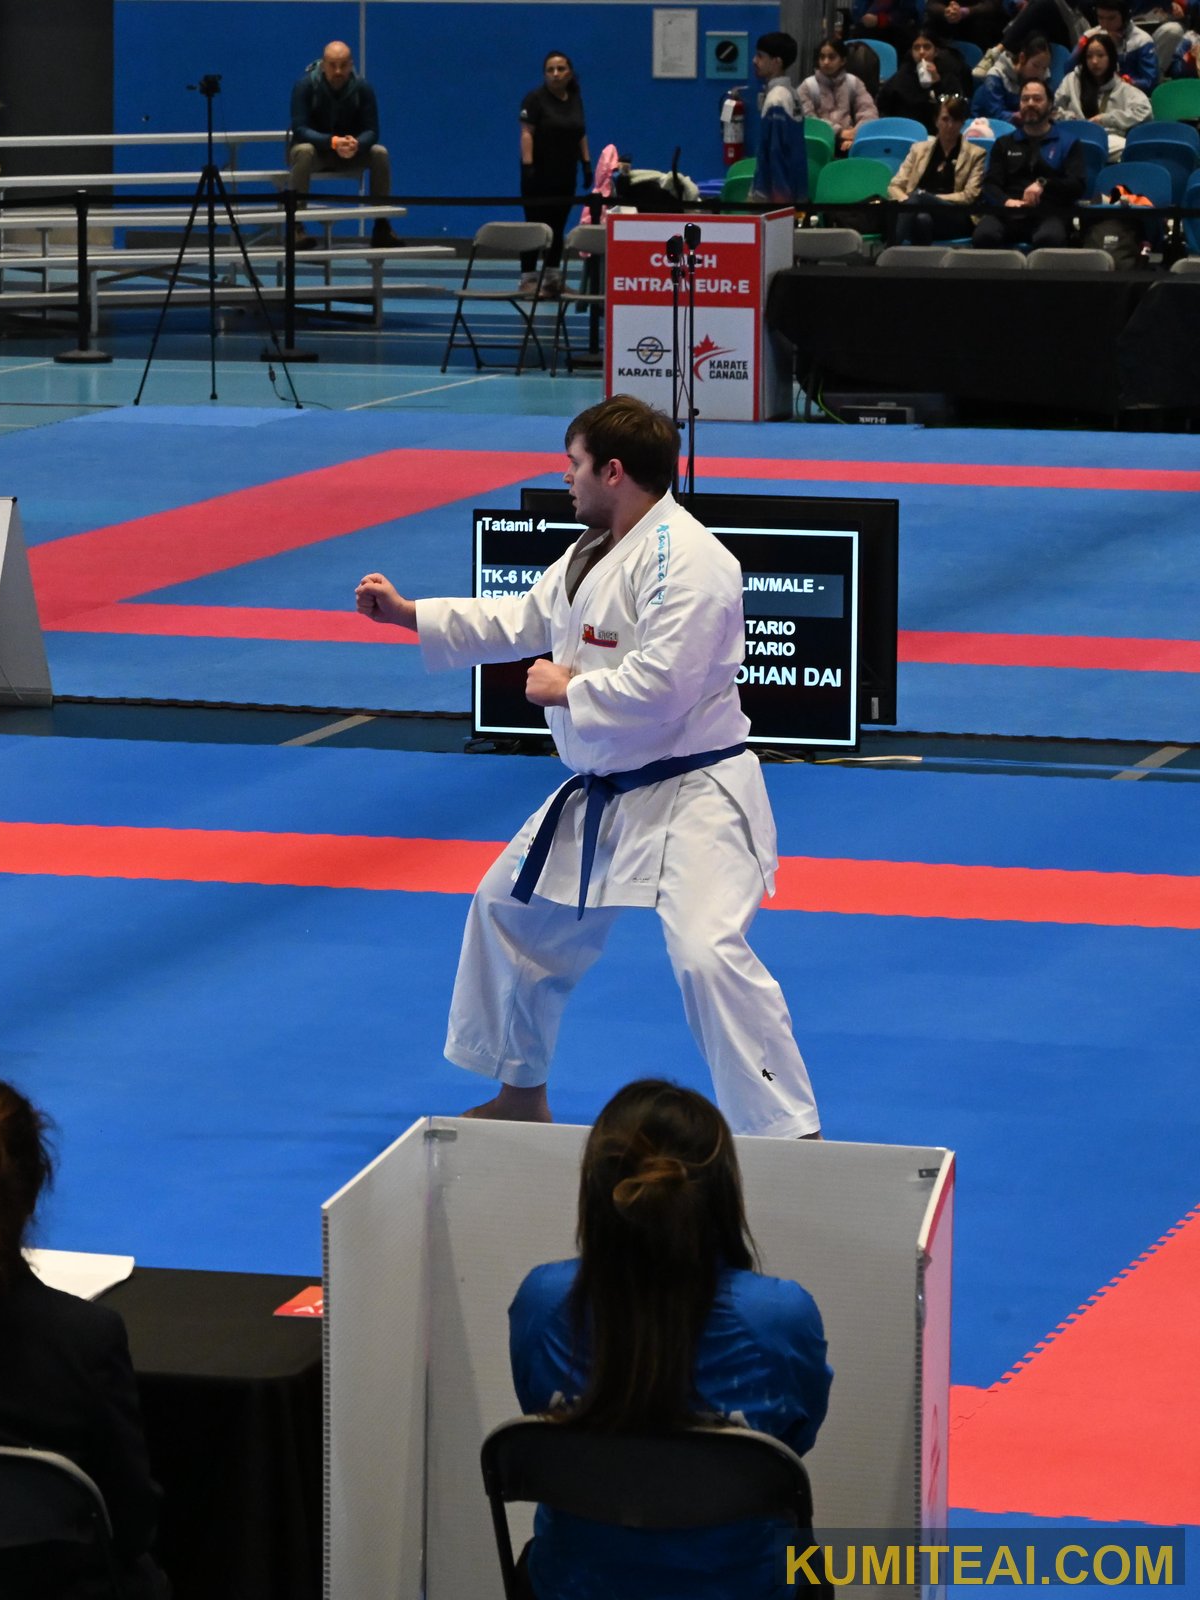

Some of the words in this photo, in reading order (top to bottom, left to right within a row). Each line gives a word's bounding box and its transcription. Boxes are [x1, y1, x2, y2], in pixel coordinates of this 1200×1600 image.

[613, 277, 750, 294] ENTRANEUR·E
[618, 367, 663, 377] KARATE
[709, 359, 748, 370] KARATE
[709, 370, 749, 380] CANADA
[482, 517, 533, 532] Tatami
[536, 518, 546, 533] 4
[482, 569, 518, 584] TK-6
[521, 570, 546, 584] KA
[745, 620, 796, 636] TARIO
[745, 641, 796, 657] TARIO
[734, 665, 797, 686] OHAN
[803, 667, 842, 687] DAI
